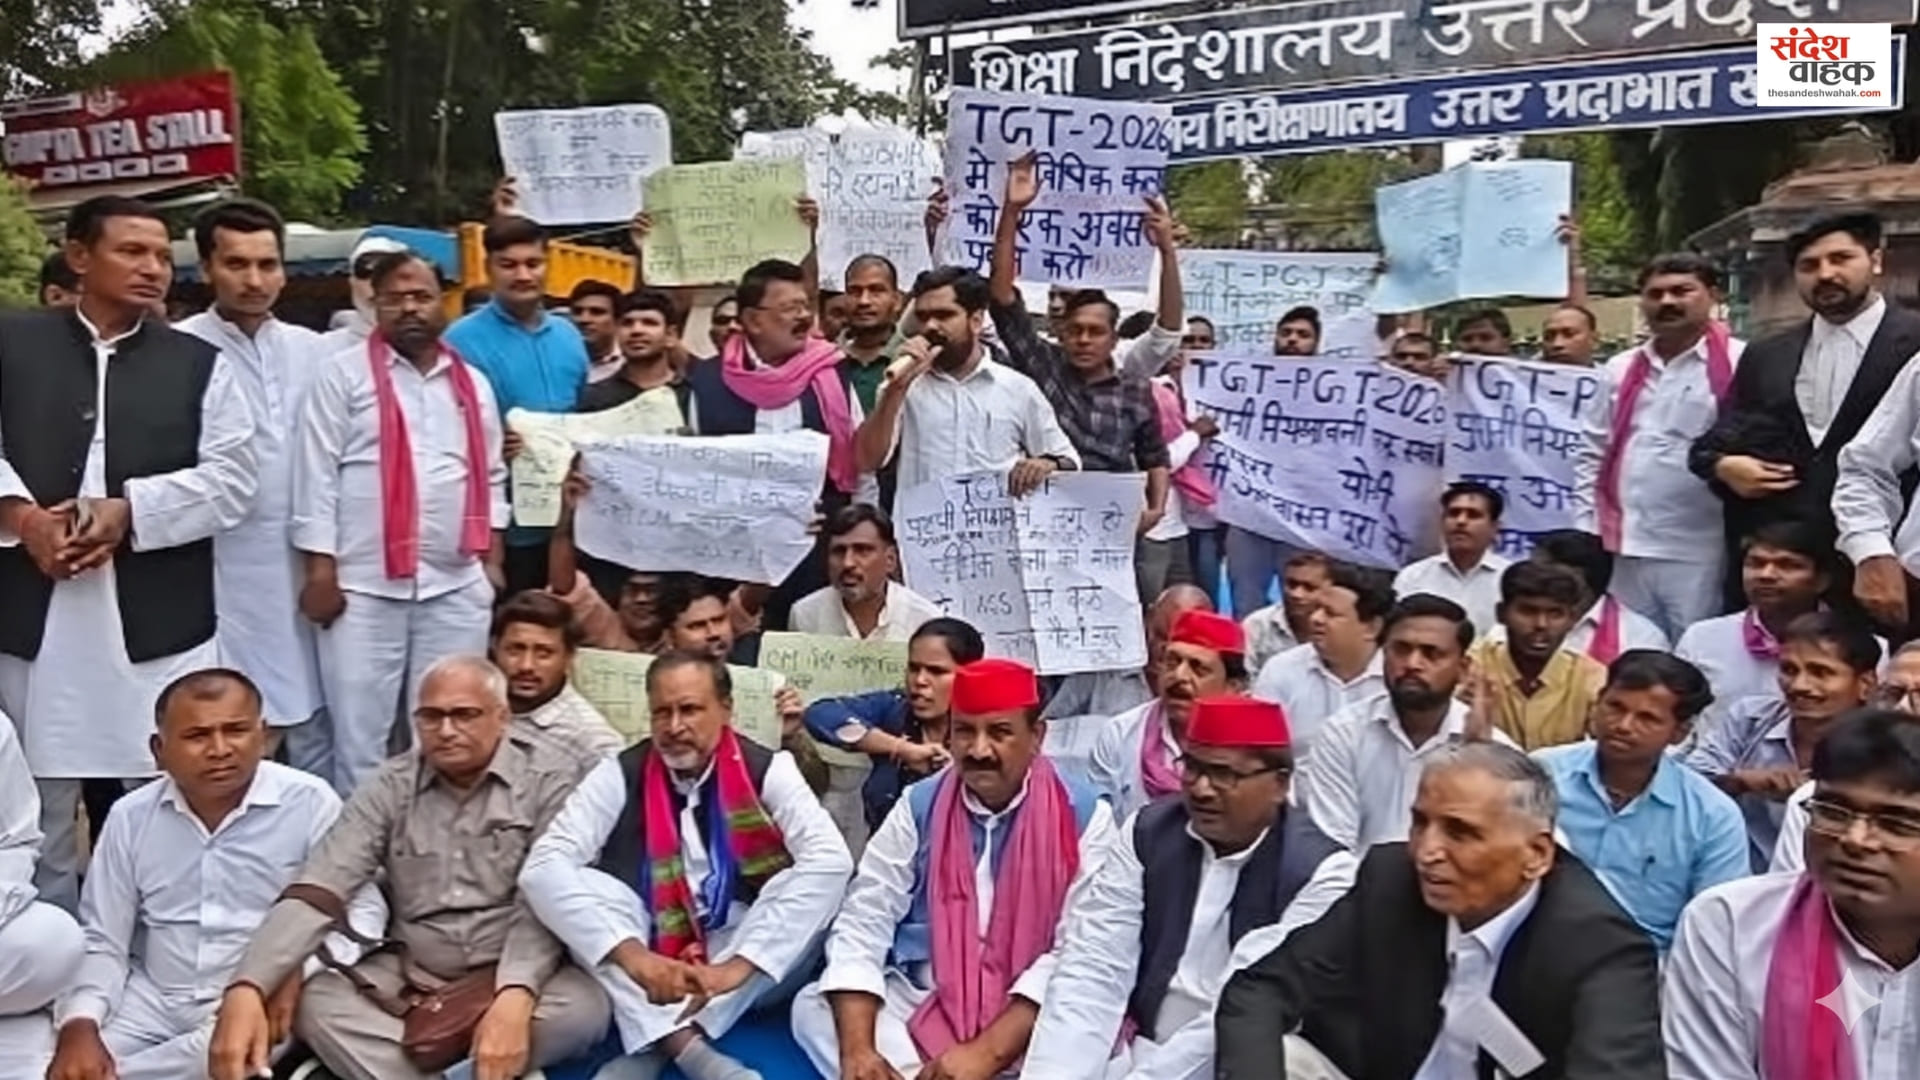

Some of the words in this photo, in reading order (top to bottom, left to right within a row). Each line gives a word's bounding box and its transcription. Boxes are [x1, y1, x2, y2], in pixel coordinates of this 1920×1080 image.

[970, 46, 1079, 95] शिक्षा
[1093, 12, 1406, 92] निदेशालय
[965, 102, 1170, 153] TGT-2026
[1430, 82, 1532, 128] उत्तर
[86, 118, 143, 157] TEA
[146, 108, 233, 150] STALL
[1041, 243, 1093, 279] करो
